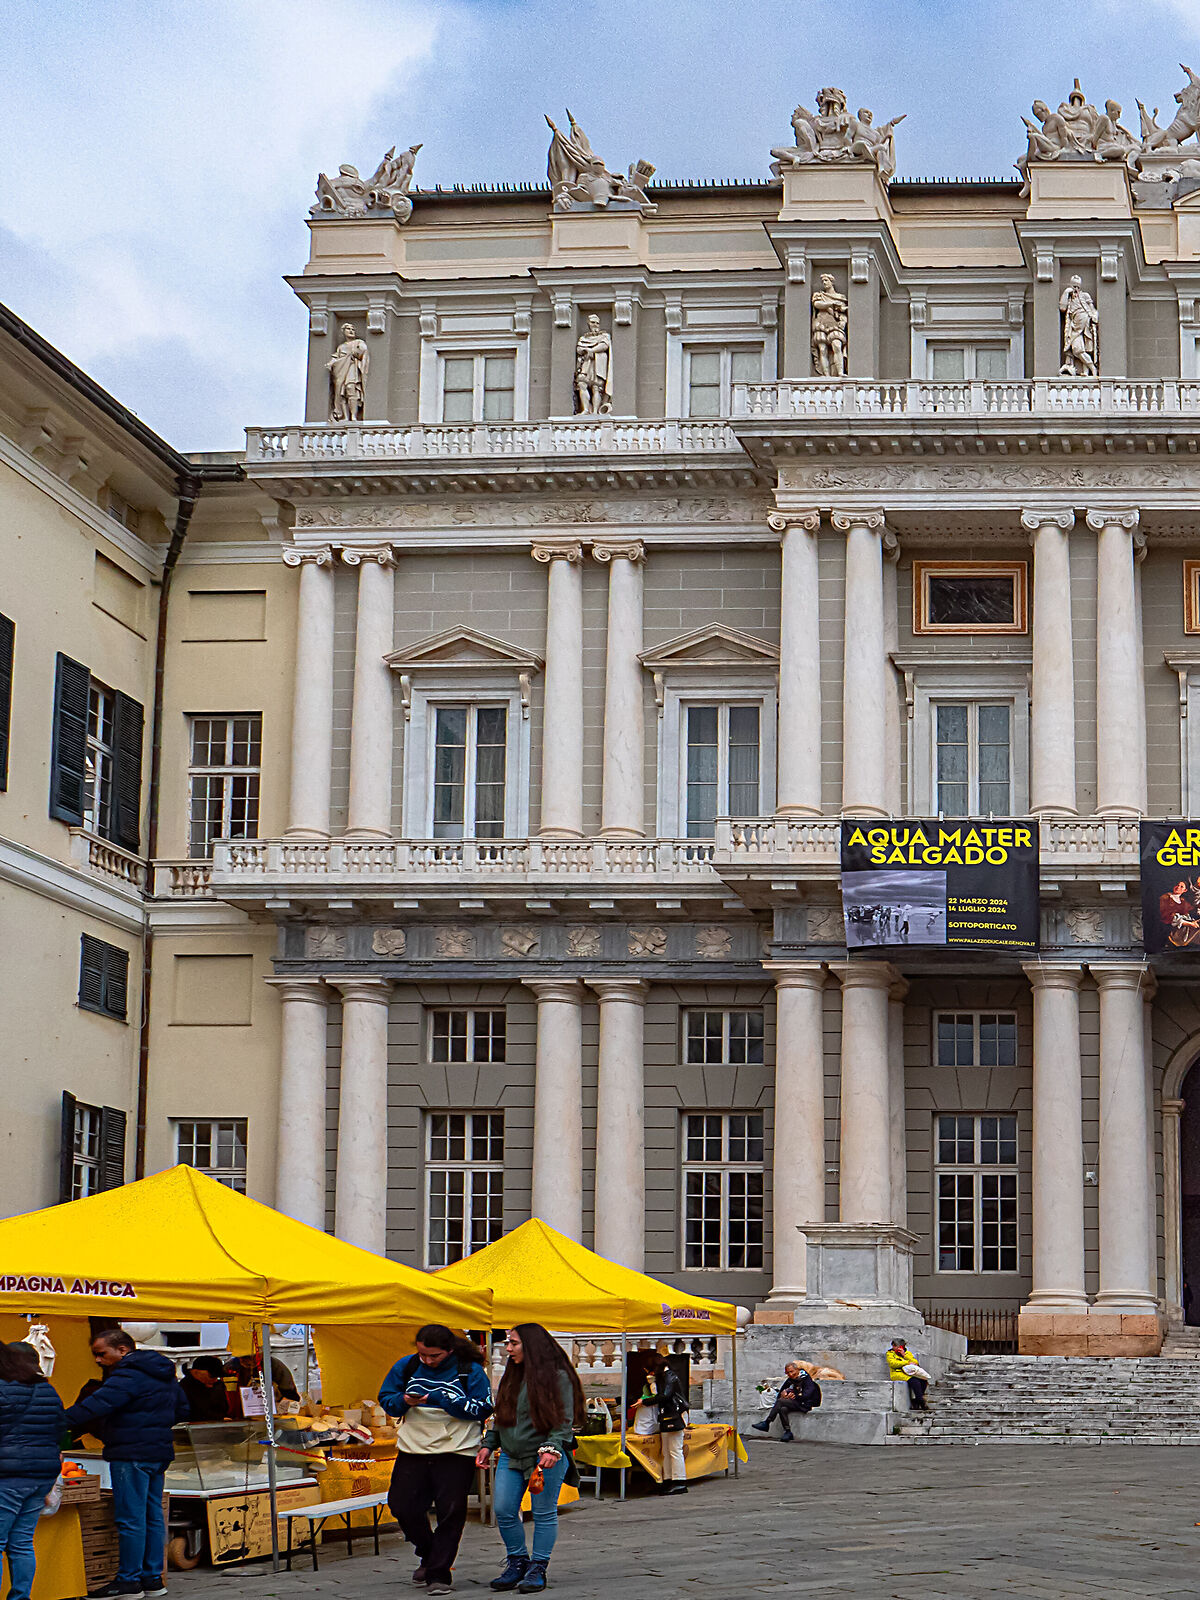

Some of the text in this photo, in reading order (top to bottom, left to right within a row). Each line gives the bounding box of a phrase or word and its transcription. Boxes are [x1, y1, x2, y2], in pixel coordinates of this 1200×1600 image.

[848, 827, 1032, 848] AQUA MATER
[870, 846, 1008, 866] SALGADO
[960, 897, 989, 905] MARZO
[990, 898, 1008, 906] 2024
[958, 905, 987, 913] LUGLIO
[988, 906, 1007, 914] 2024
[948, 921, 1018, 931] SOTTOPORTICATO
[70, 1278, 136, 1298] AMICA
